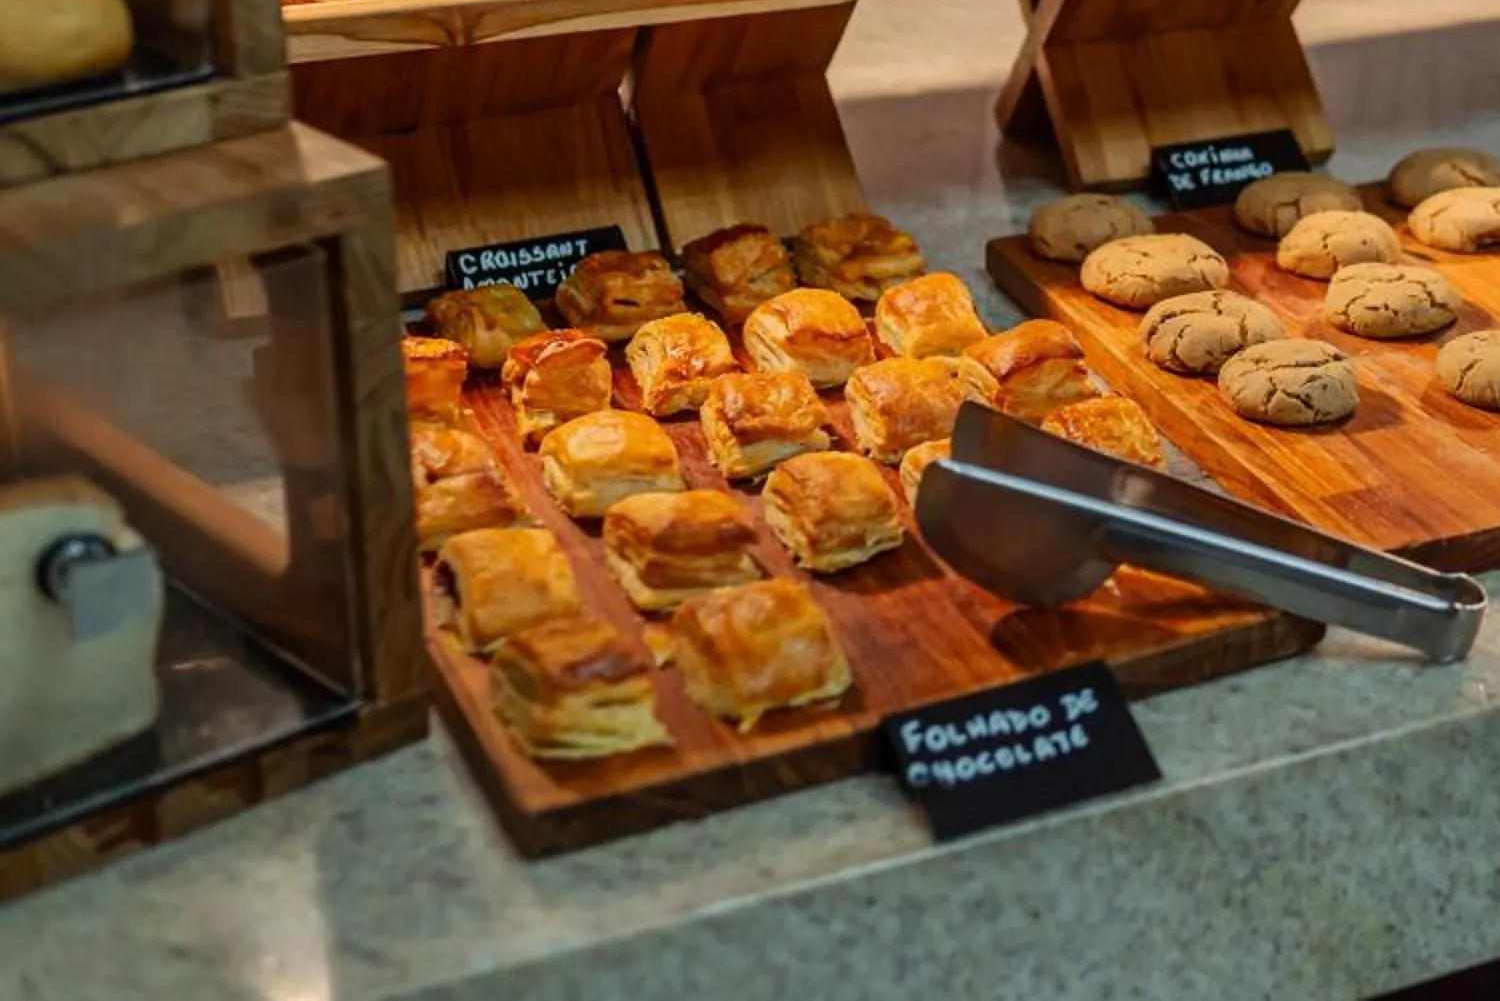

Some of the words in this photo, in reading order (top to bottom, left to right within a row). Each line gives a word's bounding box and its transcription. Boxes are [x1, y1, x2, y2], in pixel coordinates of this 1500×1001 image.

[458, 238, 588, 275] CROISSANT
[900, 704, 1051, 753] FOLHADO
[1059, 687, 1098, 723] DE
